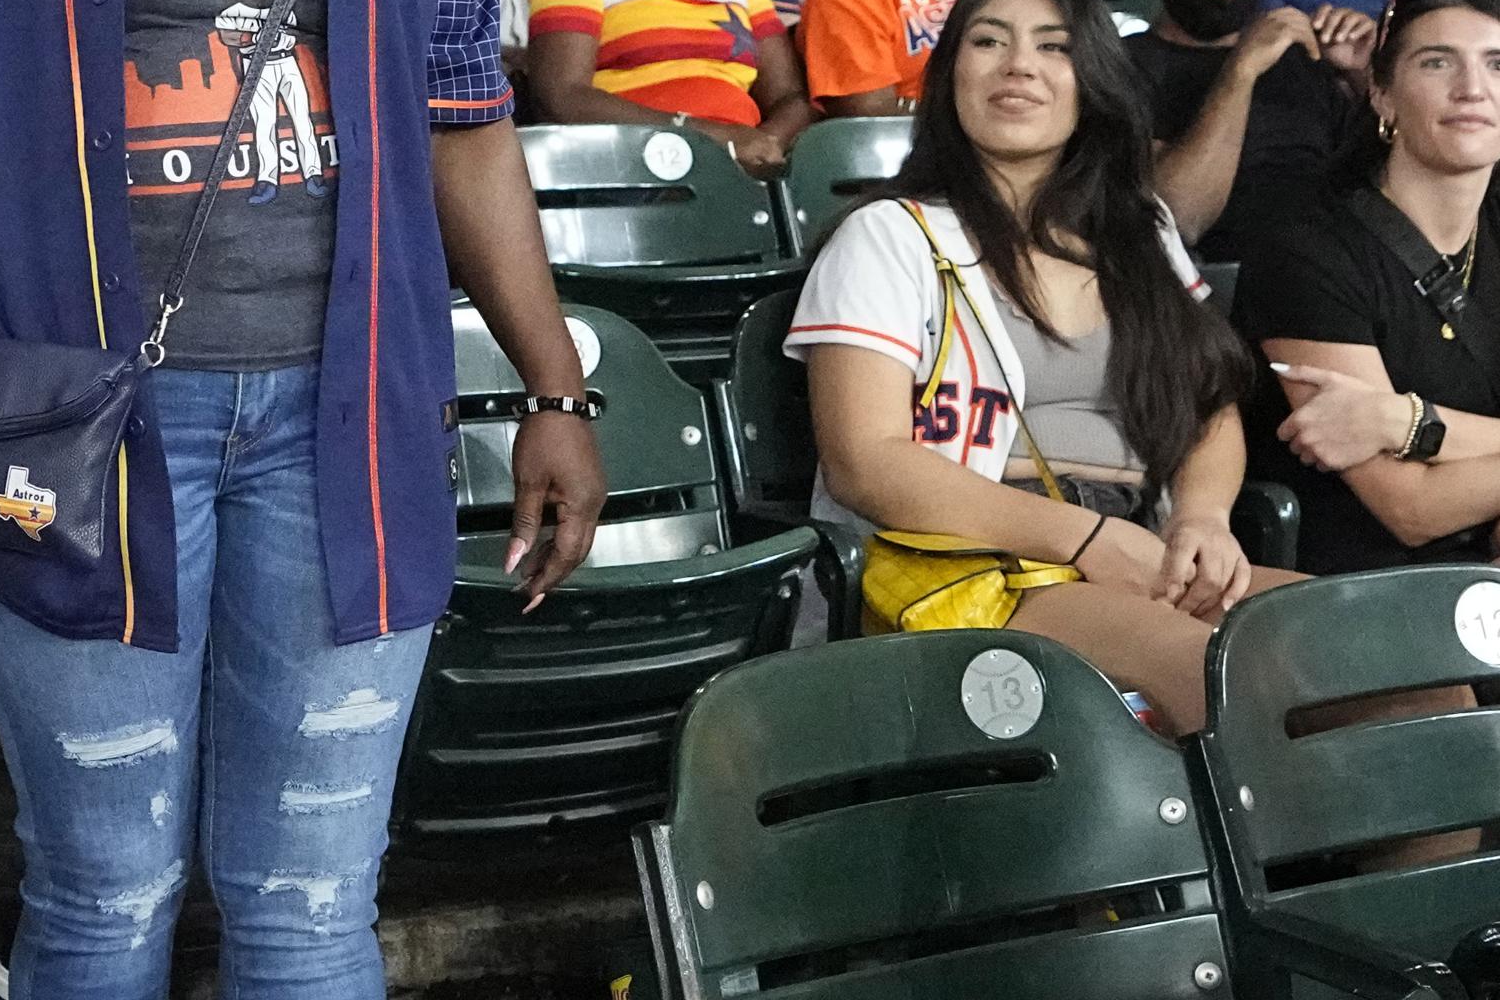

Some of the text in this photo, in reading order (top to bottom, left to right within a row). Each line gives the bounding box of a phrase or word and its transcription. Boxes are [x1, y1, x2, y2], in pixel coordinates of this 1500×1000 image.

[657, 149, 681, 165] 12
[13, 489, 45, 502] Astros
[981, 677, 1025, 713] 13
